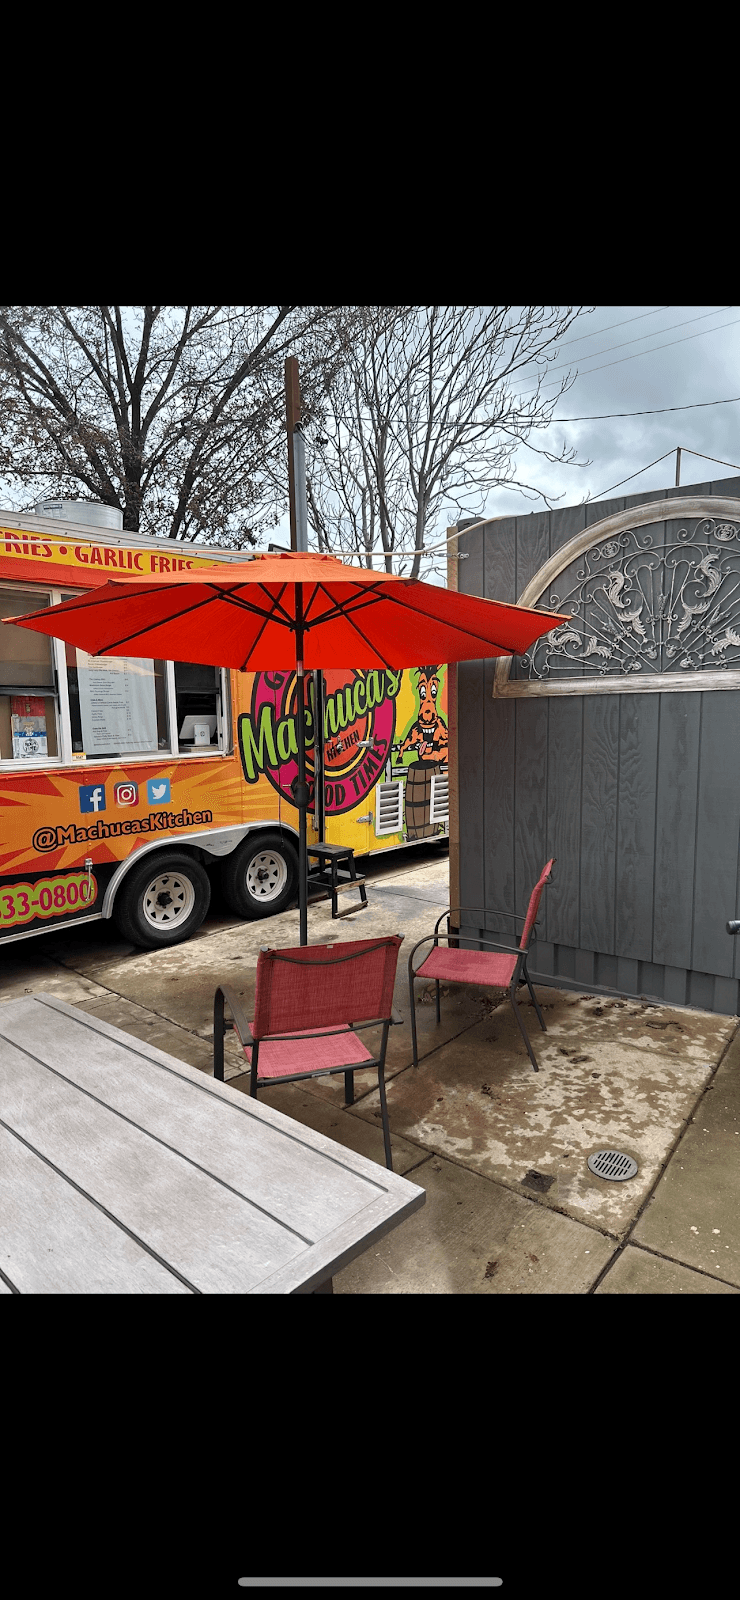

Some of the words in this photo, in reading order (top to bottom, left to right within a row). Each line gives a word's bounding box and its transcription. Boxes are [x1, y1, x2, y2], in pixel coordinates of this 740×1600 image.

[0, 531, 53, 558] RIES
[75, 546, 144, 571] GARLIC
[350, 734, 388, 796] TIMES
[32, 809, 213, 852] @MachucasKitchen
[0, 880, 92, 919] 33-0800
